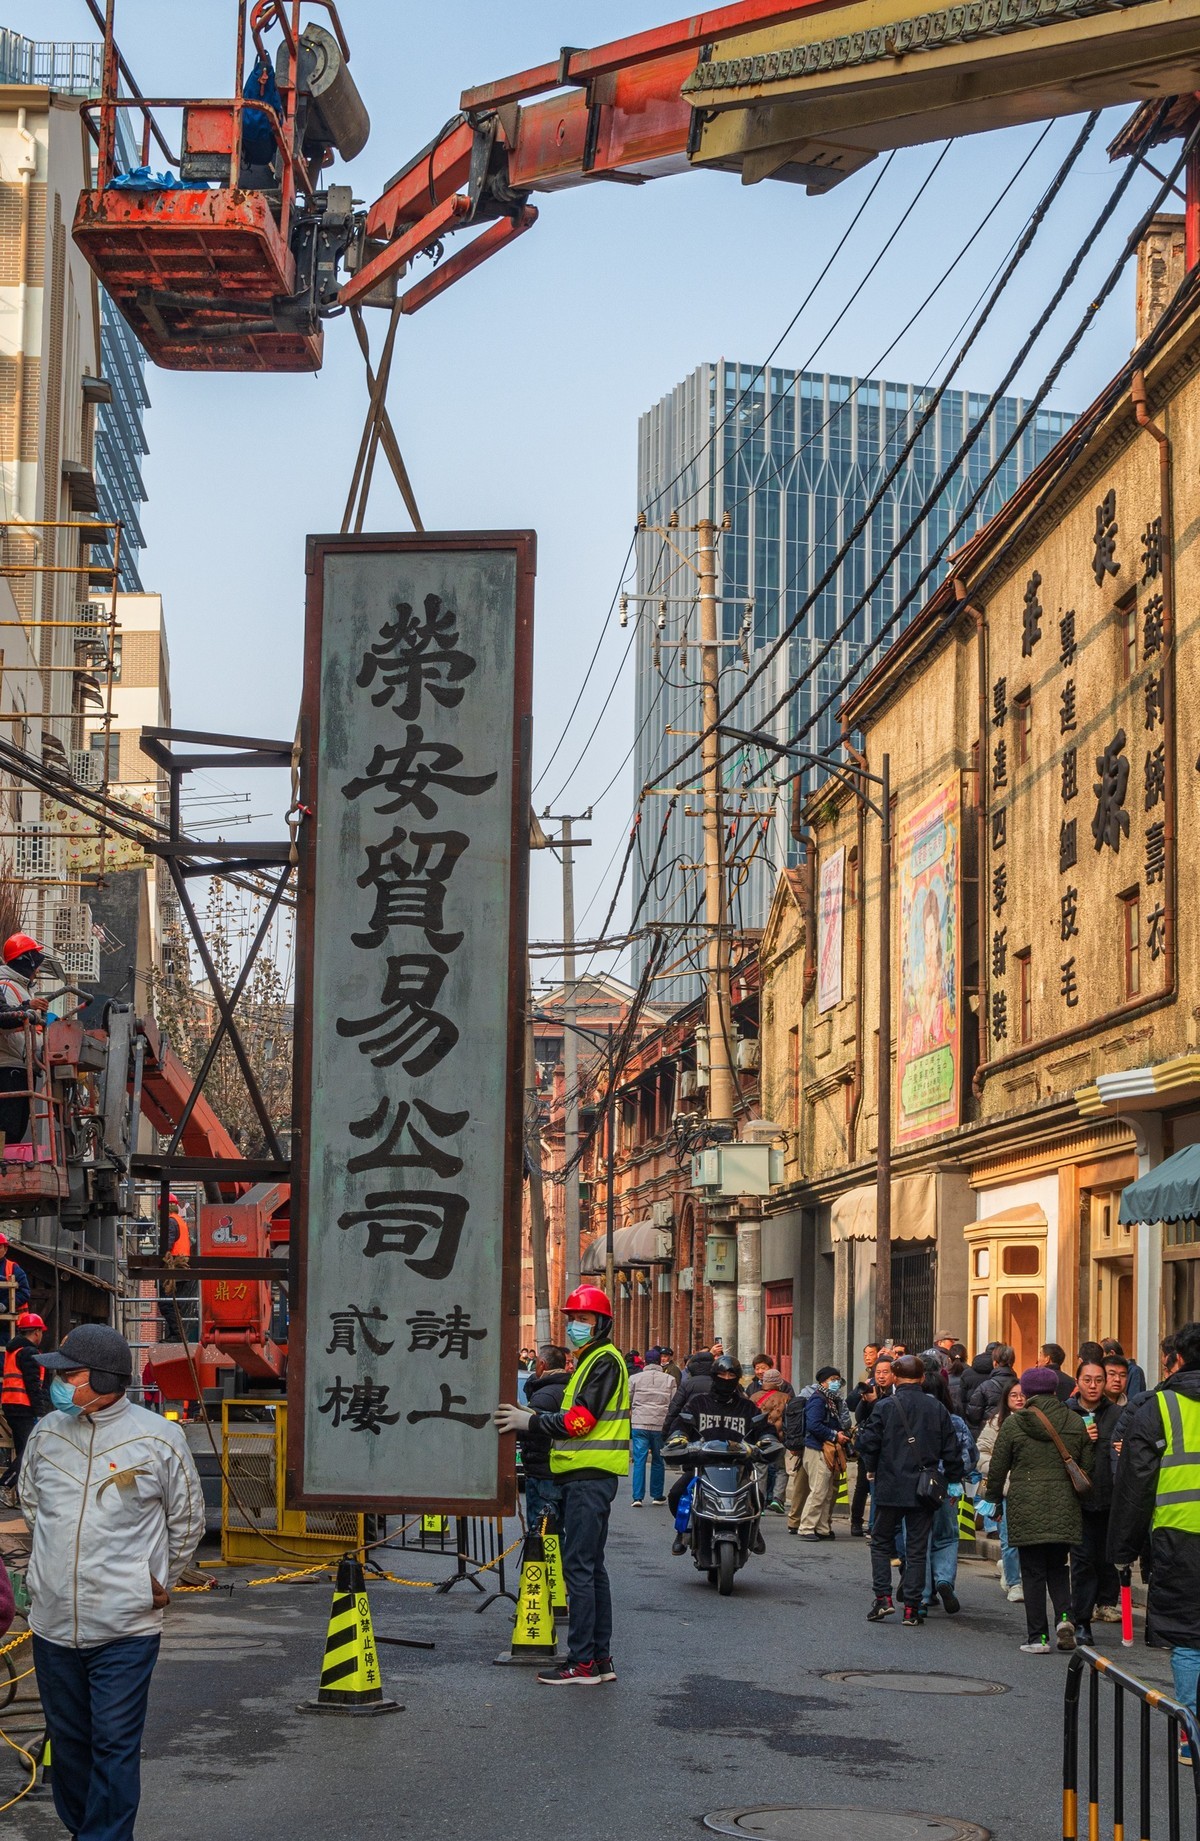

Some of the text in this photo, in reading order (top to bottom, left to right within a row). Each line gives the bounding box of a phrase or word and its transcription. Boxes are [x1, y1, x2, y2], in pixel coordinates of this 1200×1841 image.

[336, 593, 498, 1280] 榮安貿易公司
[214, 1281, 247, 1301] 鼎力
[526, 1583, 541, 1639] 禁止停车
[360, 1618, 375, 1683] 禁止停车
